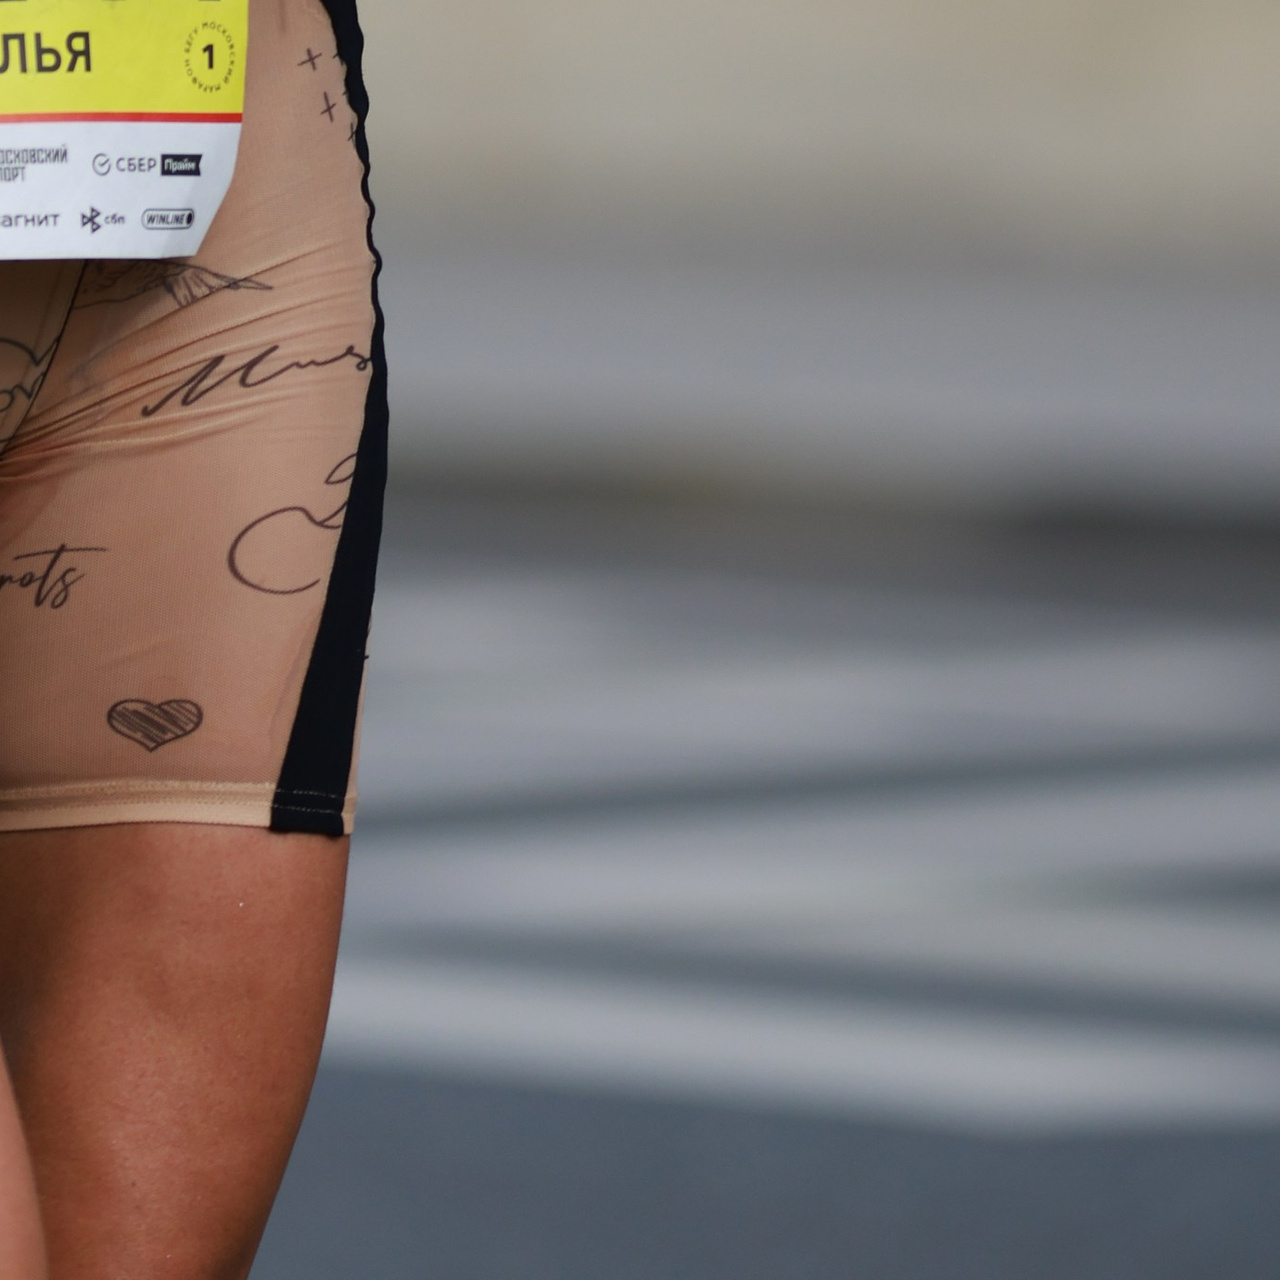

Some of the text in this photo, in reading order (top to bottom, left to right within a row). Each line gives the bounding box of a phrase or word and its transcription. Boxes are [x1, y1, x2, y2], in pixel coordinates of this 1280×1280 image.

[201, 42, 215, 70] 1
[115, 156, 197, 175] СБЕР Прайм
[146, 213, 186, 225] WINLINE
